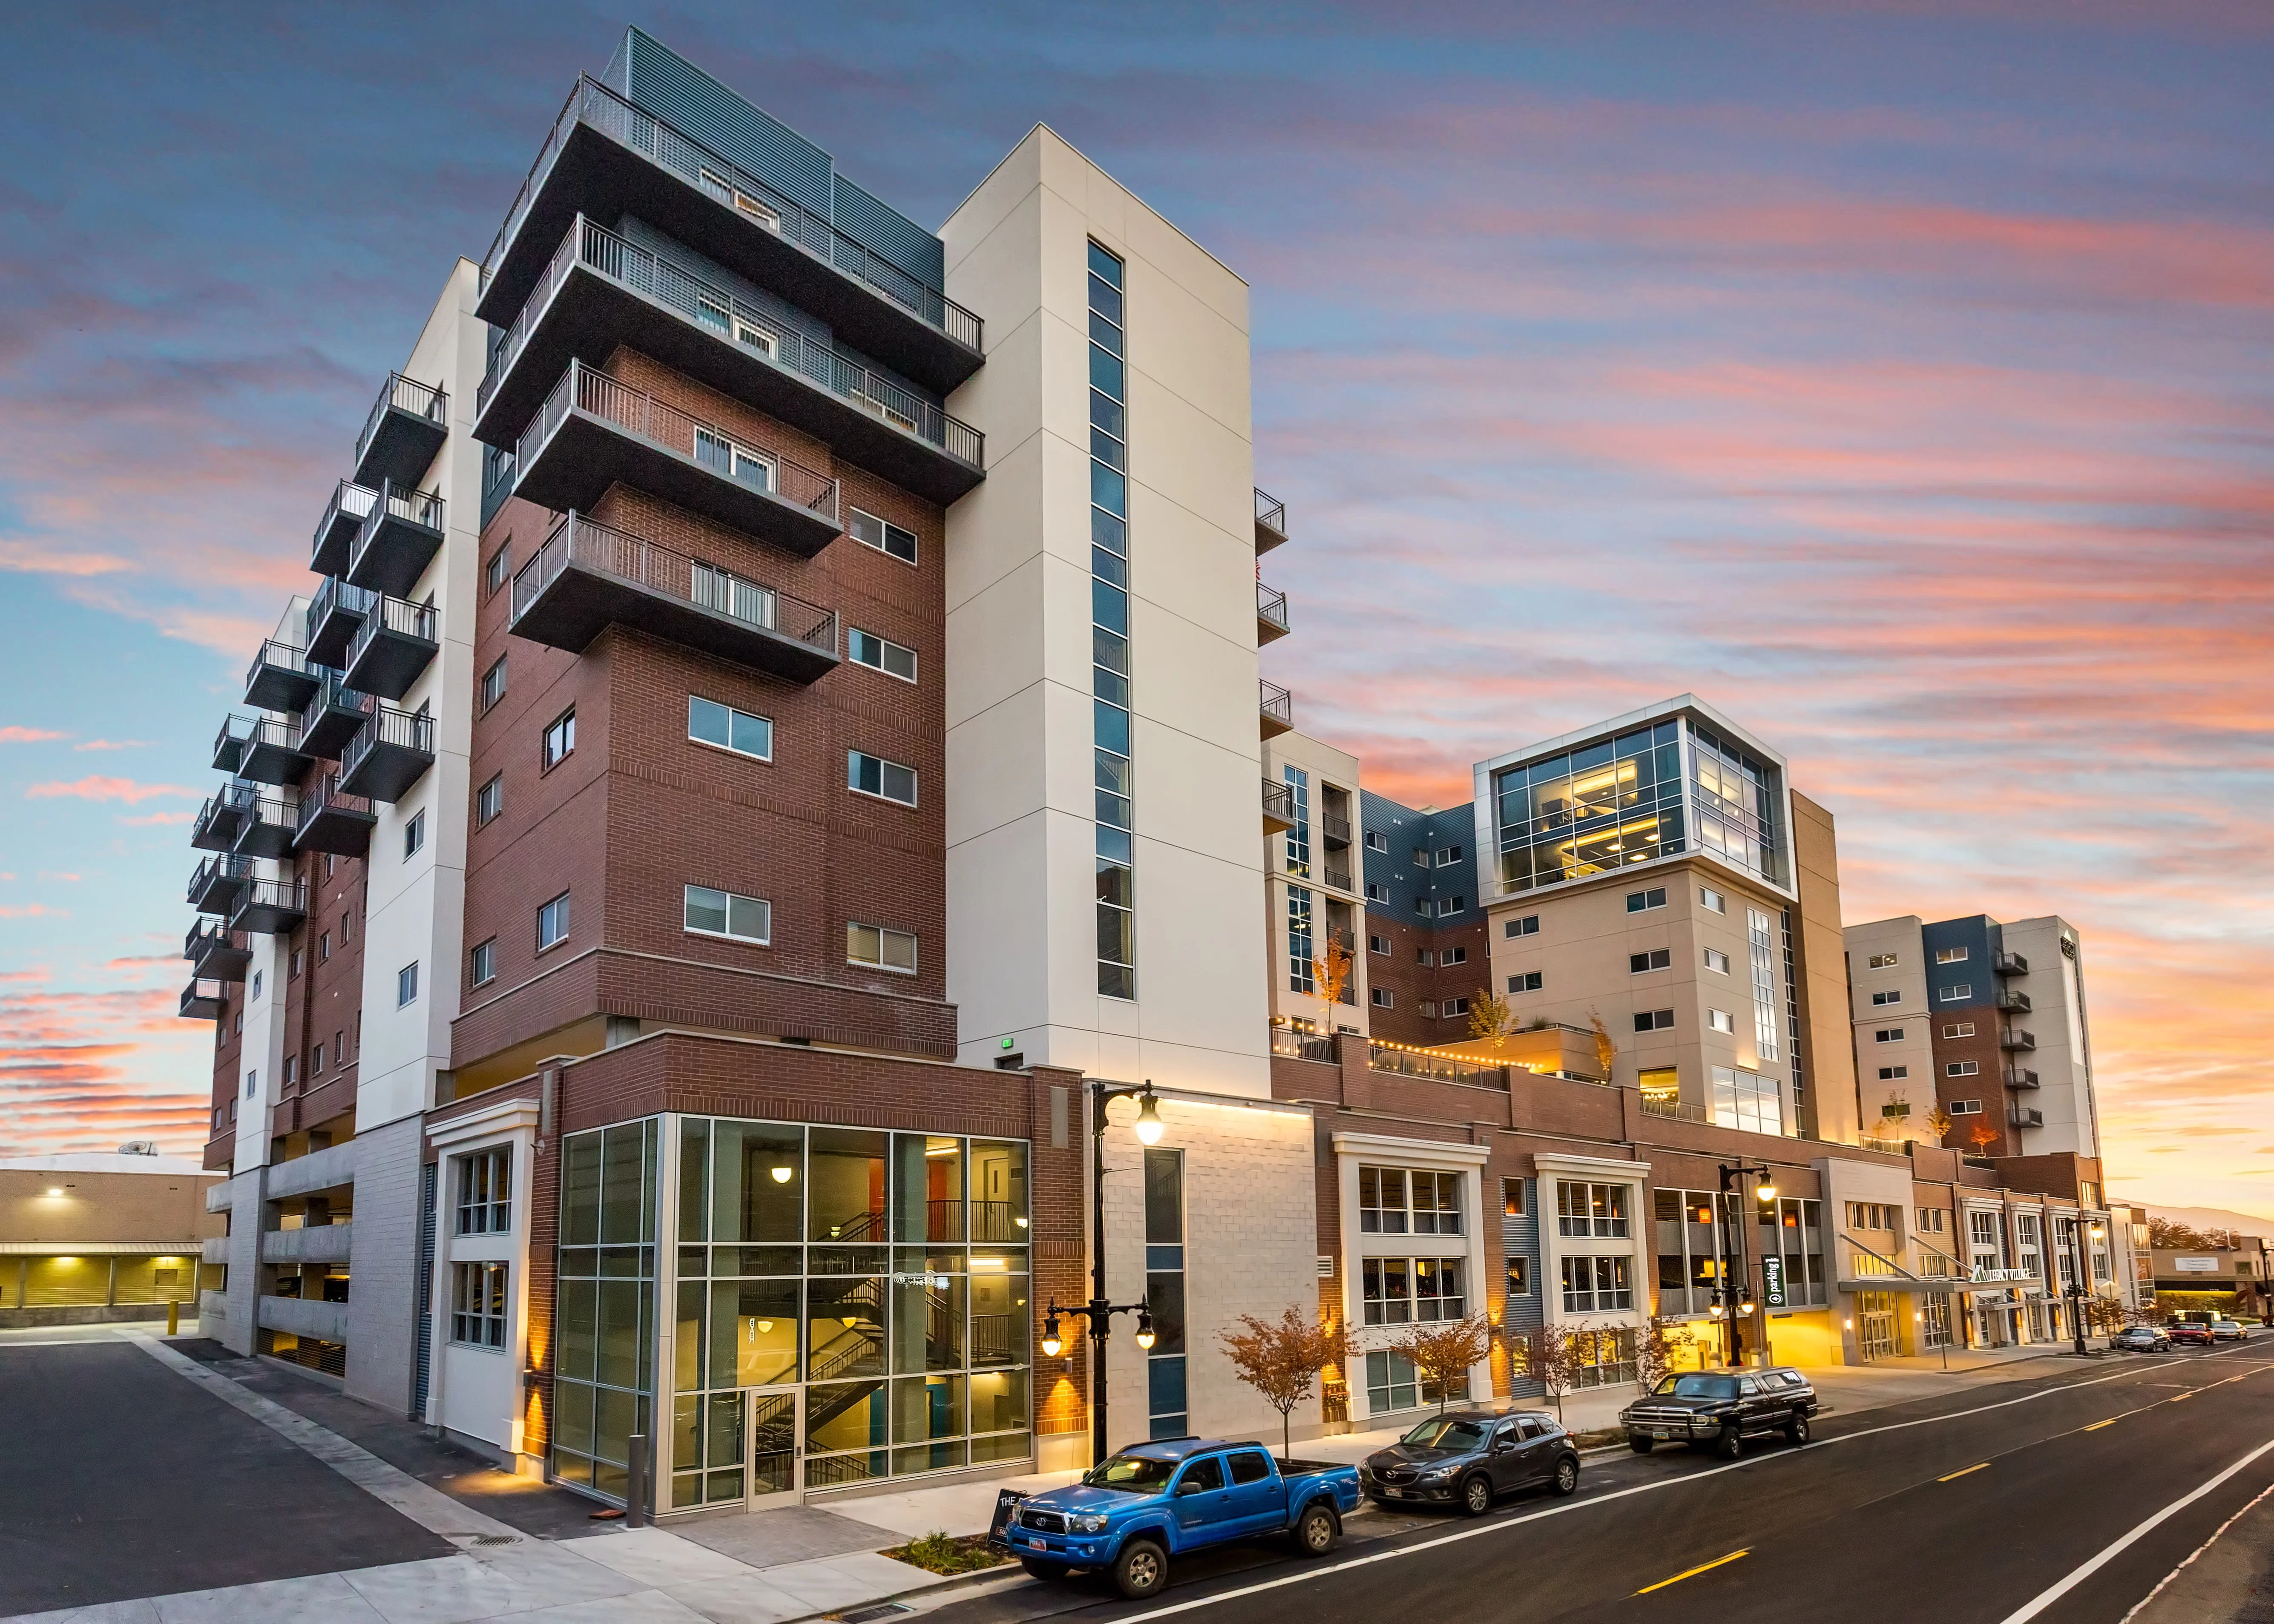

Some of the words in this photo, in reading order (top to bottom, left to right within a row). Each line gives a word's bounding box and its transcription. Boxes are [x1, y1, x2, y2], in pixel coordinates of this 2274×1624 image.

[1767, 1263, 1781, 1292] parking
[1989, 1269, 2009, 1282] LEGACY
[2010, 1268, 2030, 1280] VILLAGE
[1000, 1497, 1016, 1507] THE
